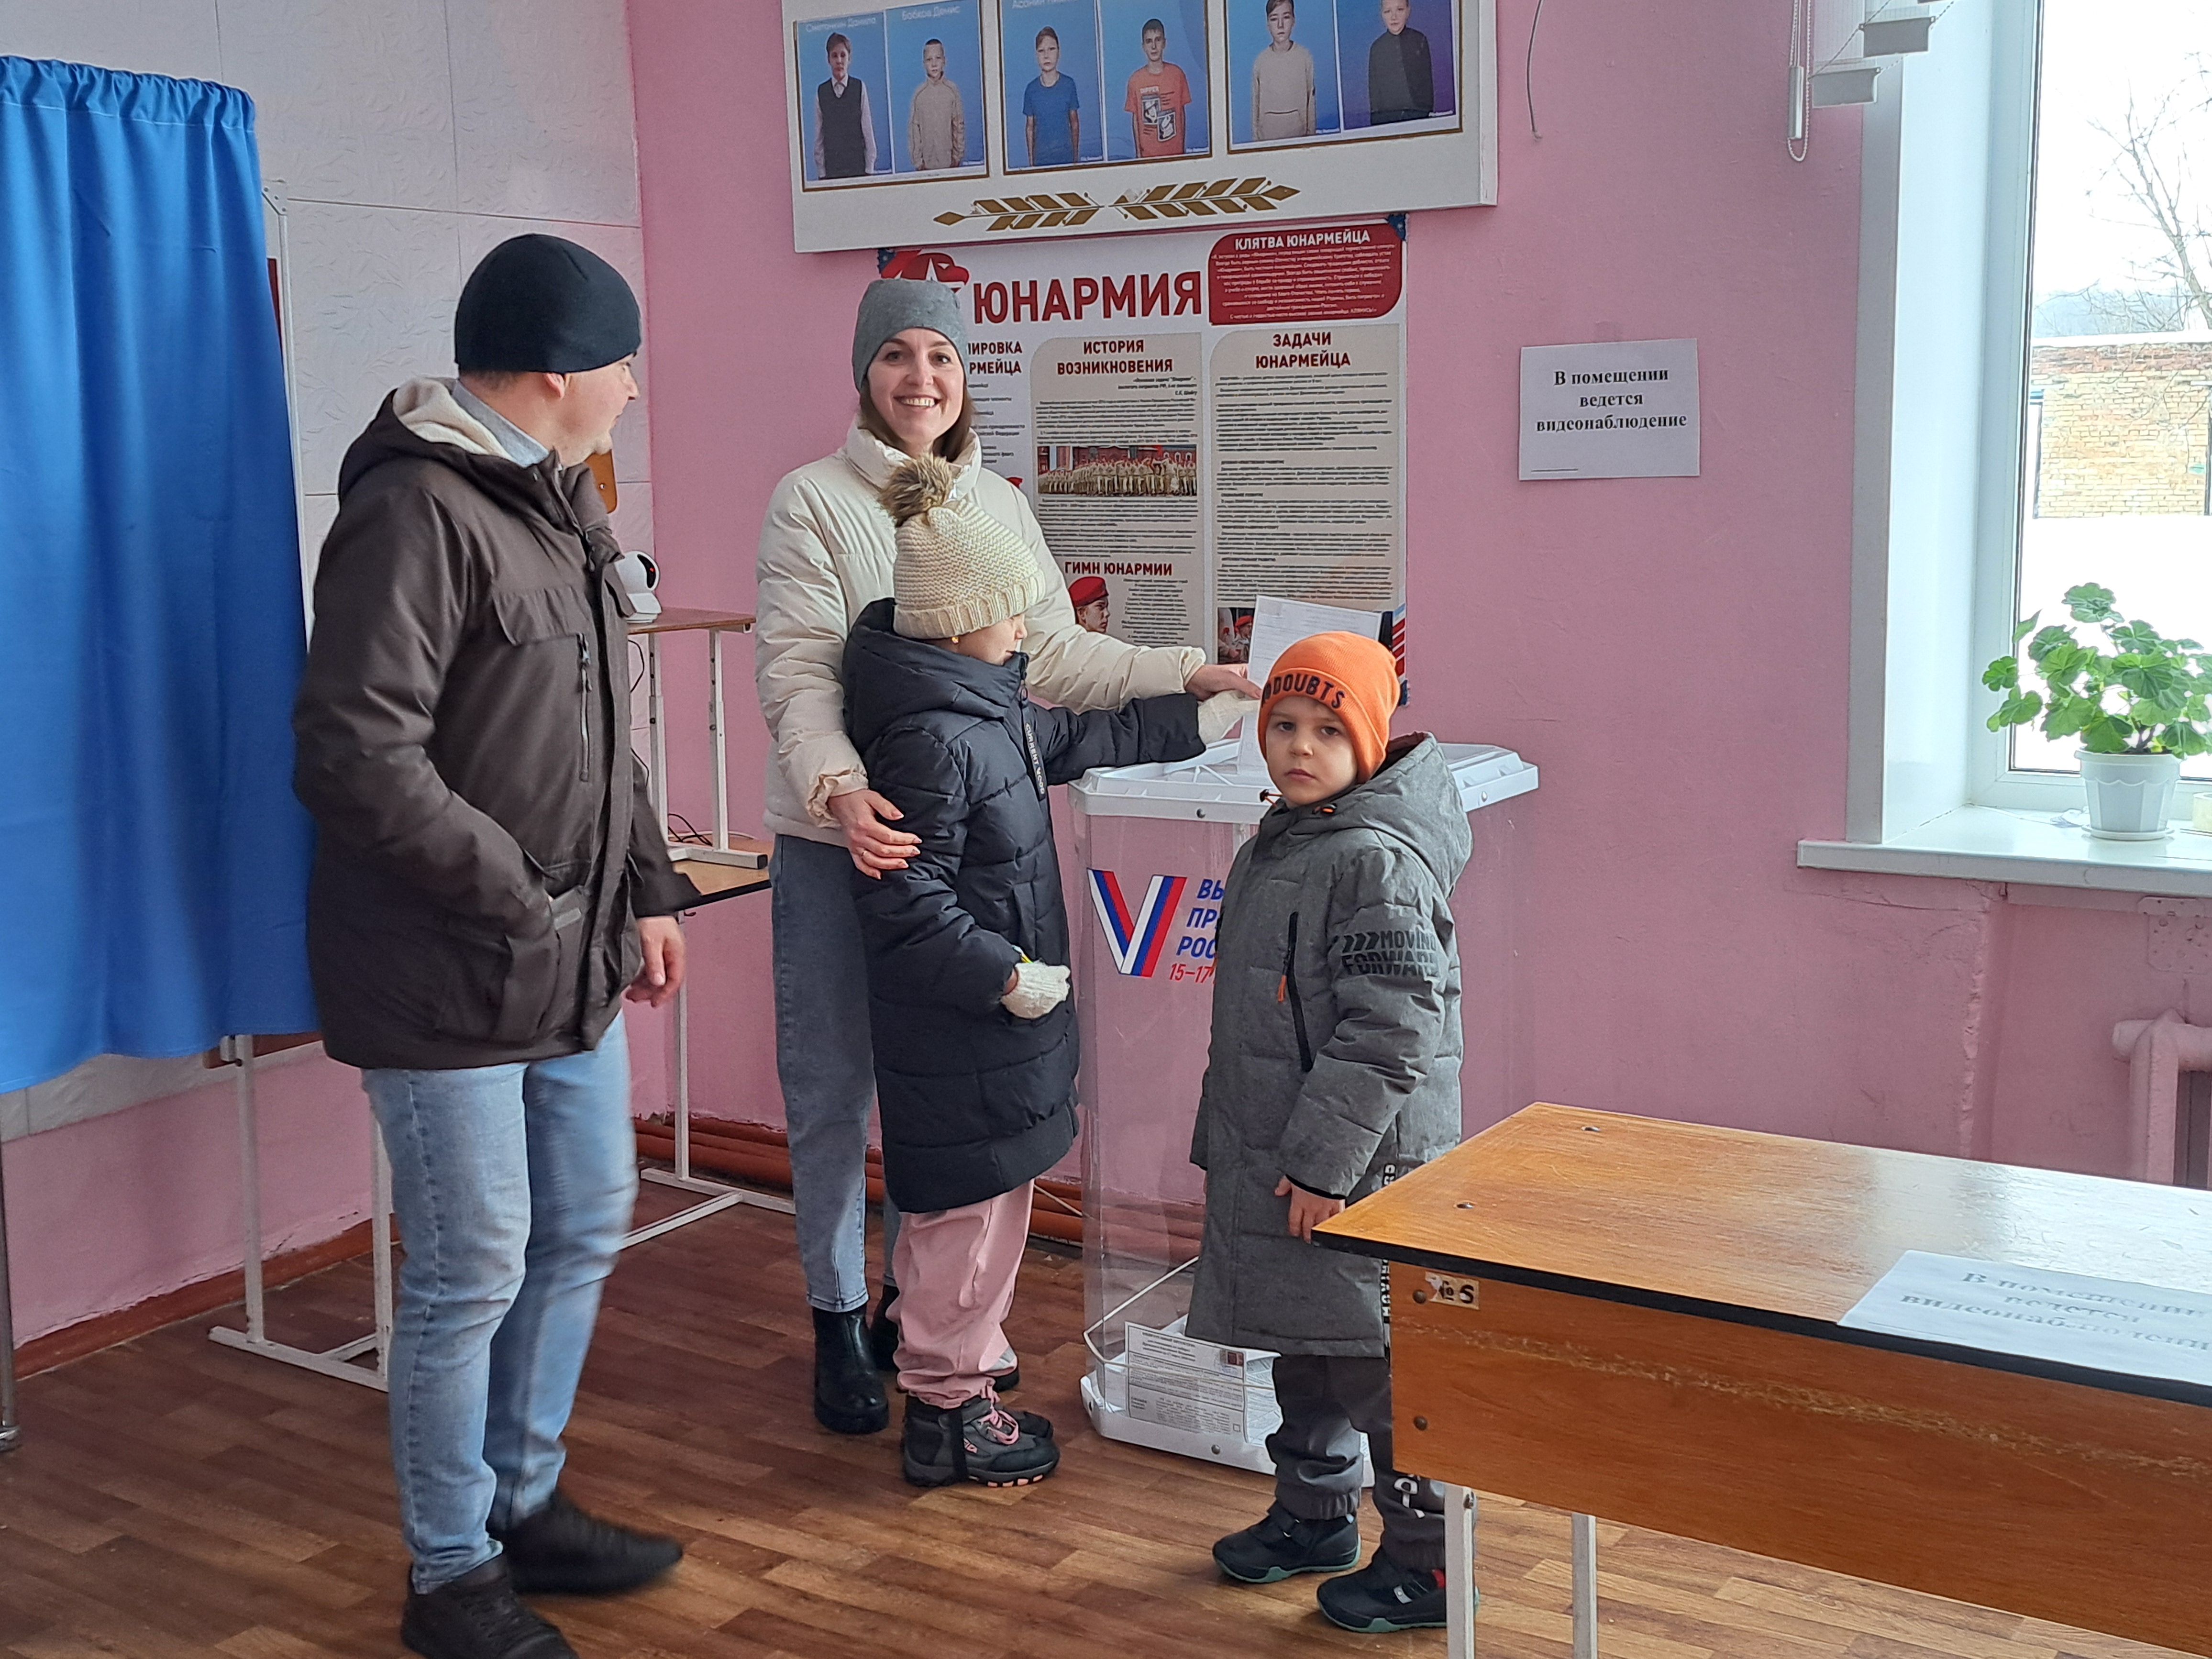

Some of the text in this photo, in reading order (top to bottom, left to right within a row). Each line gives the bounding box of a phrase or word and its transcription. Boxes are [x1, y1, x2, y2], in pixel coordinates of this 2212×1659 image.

[1235, 229, 1370, 251] КЛЯТВА ЮНАРМЕЙЦА
[973, 270, 1202, 324] ЮНАРМИЯ
[968, 341, 1023, 355] ИРОВКА
[1084, 339, 1144, 354] ИСТОРИЯ
[1272, 332, 1331, 349] ЗАДАЧИ
[969, 358, 1022, 376] РМЕЙЦА
[1057, 358, 1173, 375] ВОЗНИКНОВЕНИЯ
[1256, 350, 1351, 369] ЮНАРМЕЙЦА
[1554, 369, 1668, 386] В помещении
[1580, 394, 1643, 408] ведется
[1537, 414, 1687, 432] видеонаблюдение
[1065, 561, 1172, 576] ГИМН ЮНАРМИИ
[1272, 673, 1346, 708] DOUBTS
[1197, 878, 1225, 900] ВЫ
[1186, 907, 1217, 929] ПР
[1176, 936, 1216, 959] РОС
[1900, 1295, 2212, 1350] видеонаблюдени
